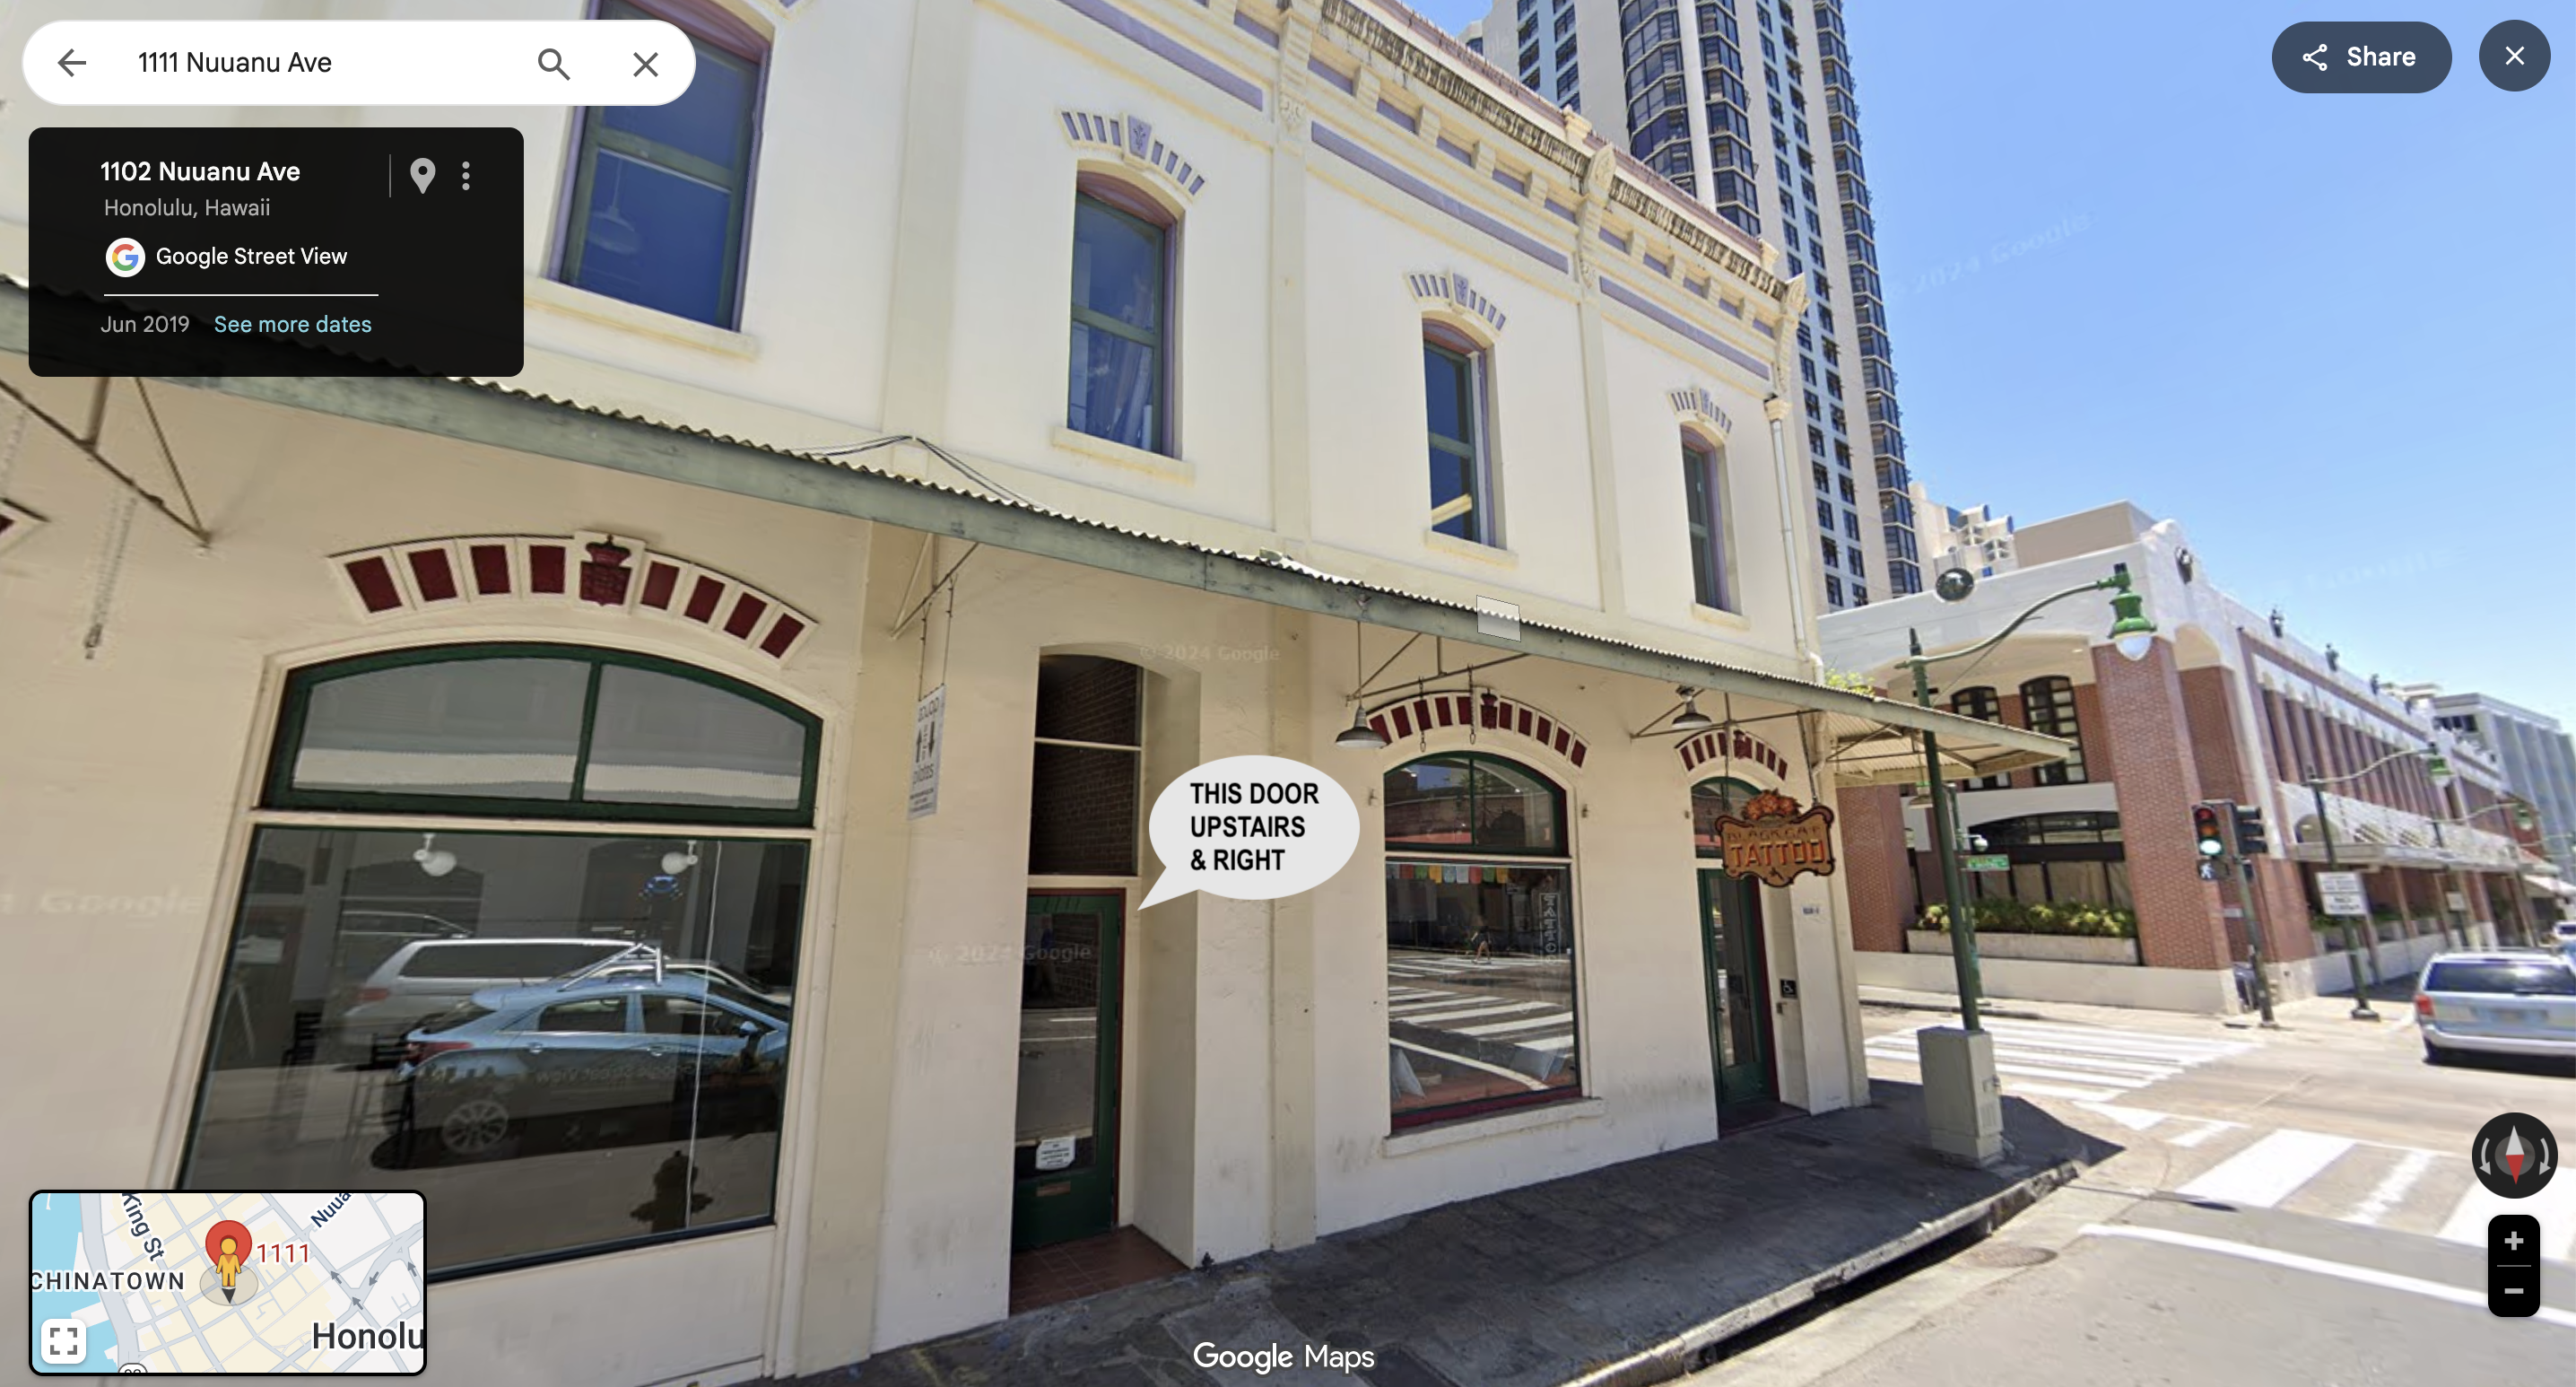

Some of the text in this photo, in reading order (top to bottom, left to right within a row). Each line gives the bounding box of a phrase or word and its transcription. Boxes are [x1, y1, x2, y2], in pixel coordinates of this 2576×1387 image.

[1727, 824, 1821, 842] BLACK CAT
[1730, 839, 1825, 868] TATTOO
[1543, 894, 1558, 965] TATTOO
